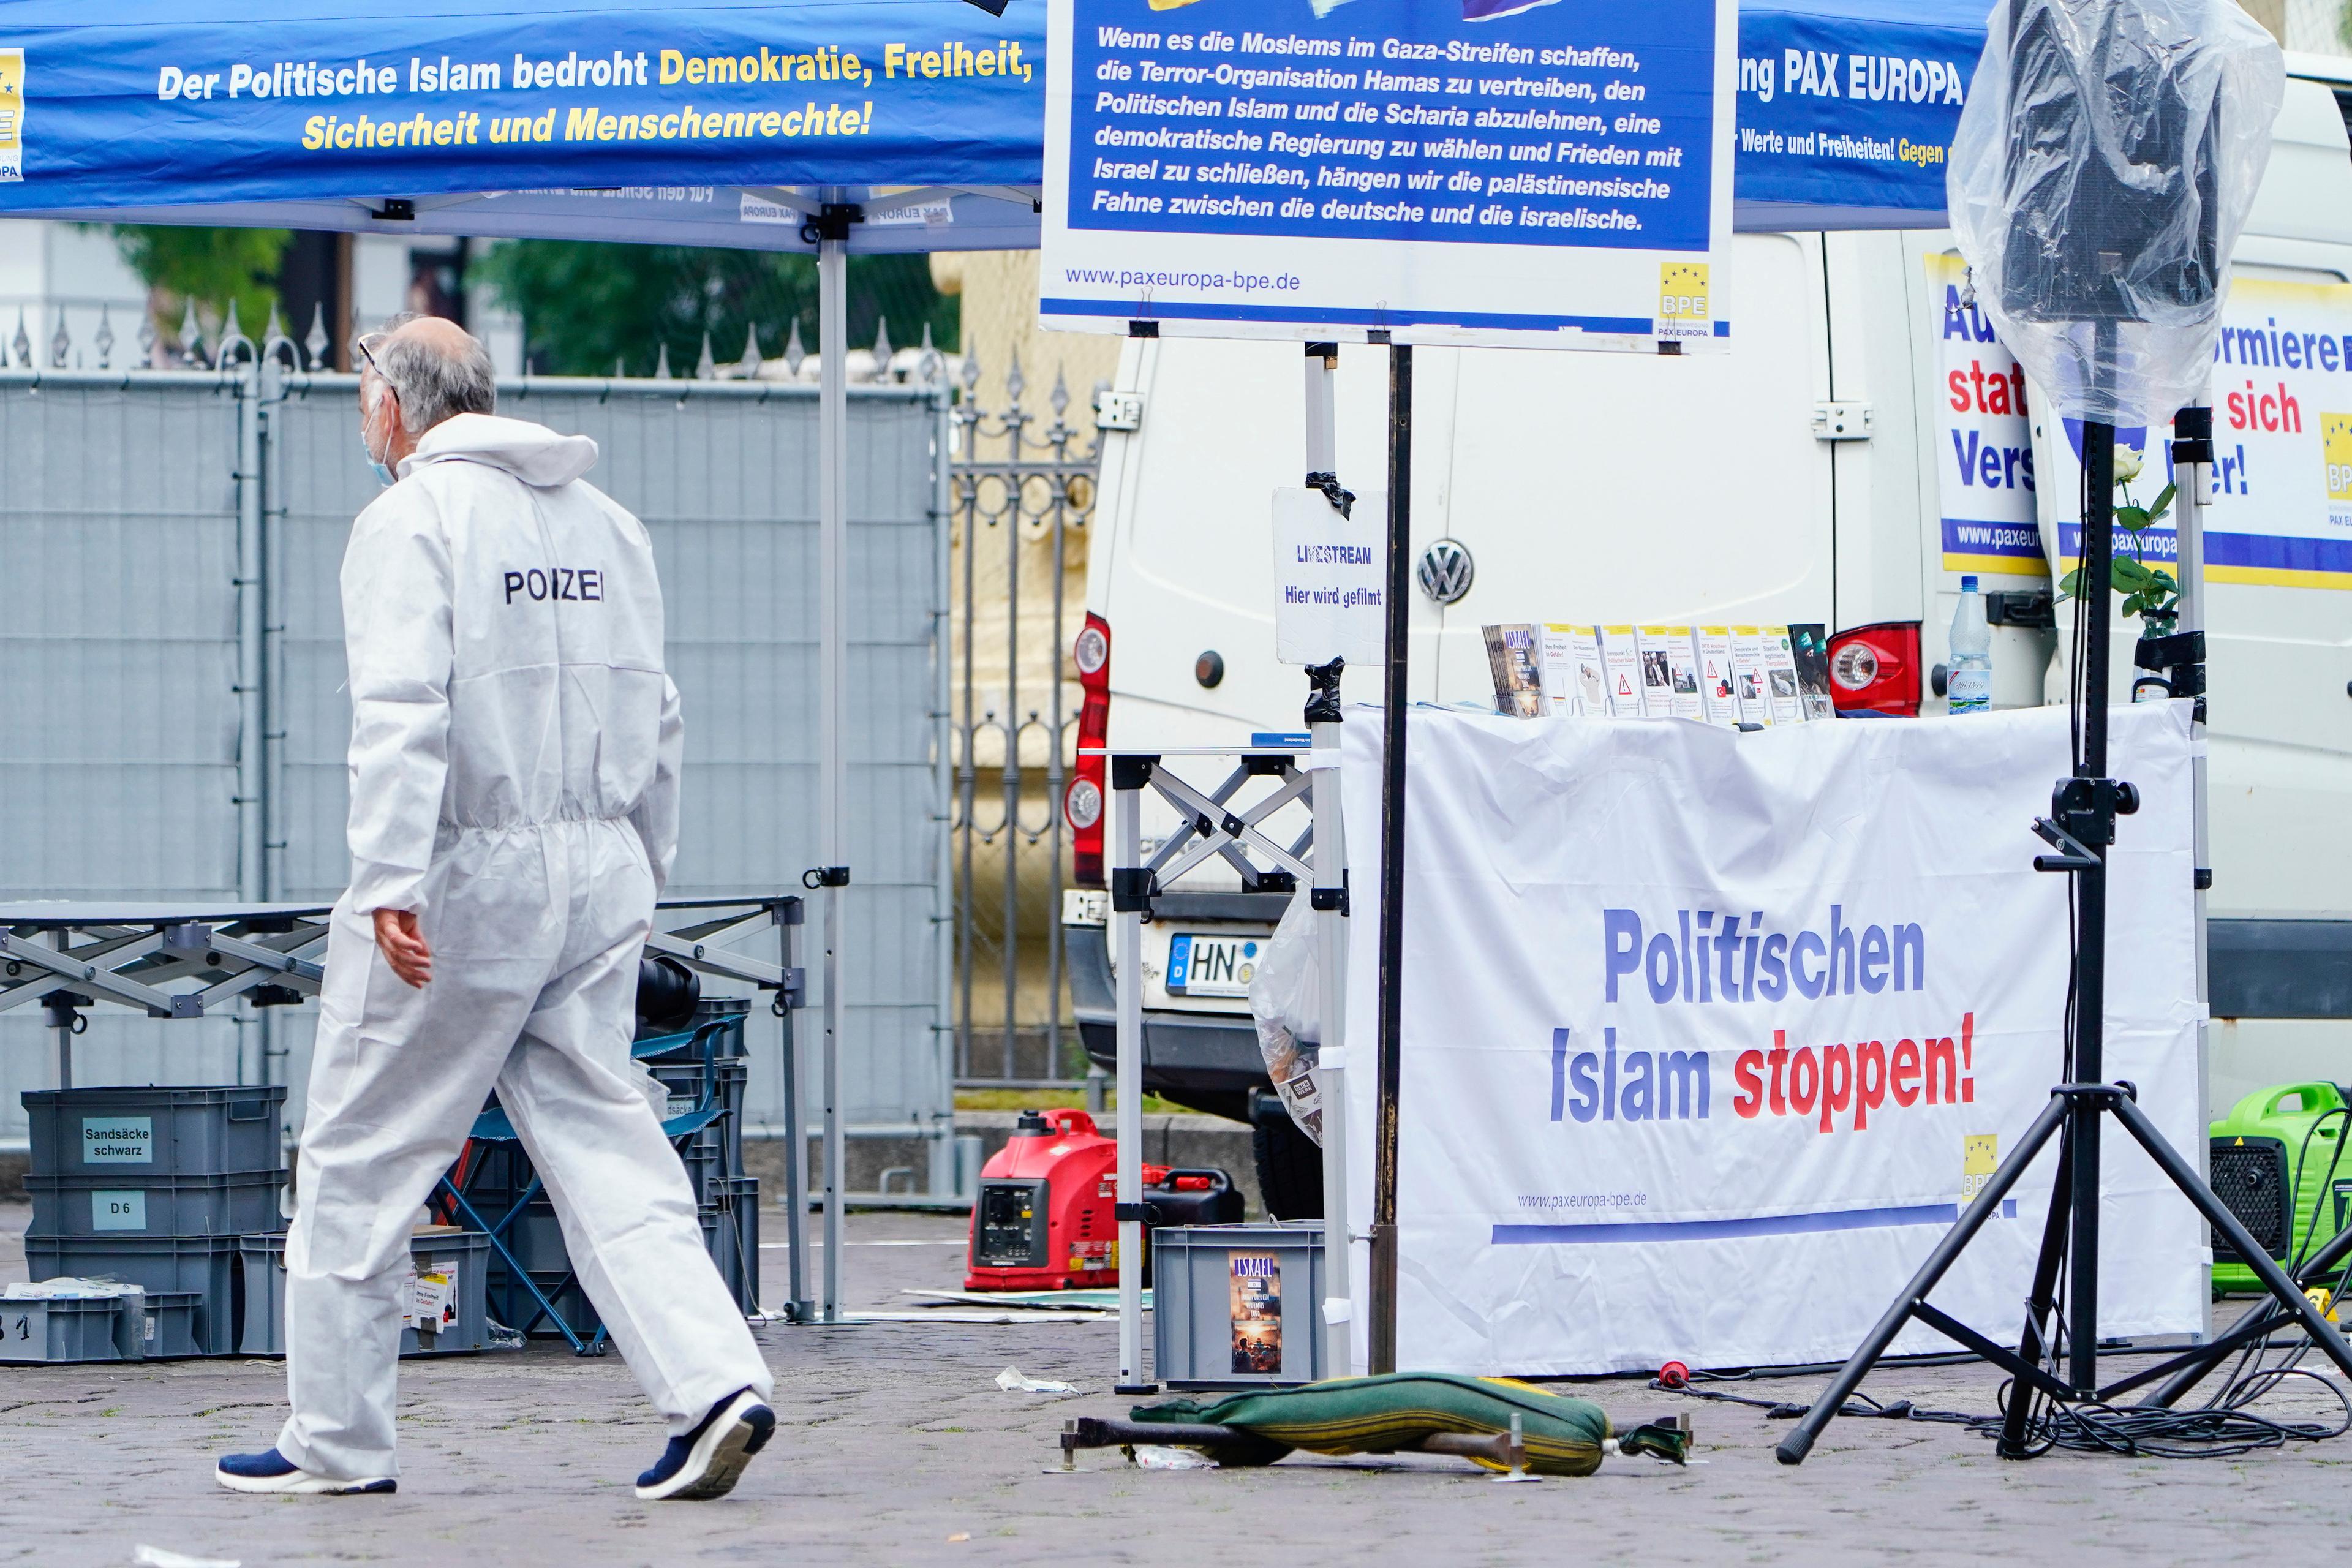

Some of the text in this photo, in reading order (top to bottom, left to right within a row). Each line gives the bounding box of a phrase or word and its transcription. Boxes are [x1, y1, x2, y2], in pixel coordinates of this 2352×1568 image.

[158, 40, 1031, 99] Der Politische Islam bedroht Demokratie, Freiheit,
[1099, 27, 1639, 72] Wenn es die Moslems im Gaza-Streifen schaffen,
[1097, 60, 1645, 103] die Terror-Organisation Hamas zu vertreiben, den
[1785, 49, 1839, 97] PAX
[1850, 55, 1963, 105] EUROPA
[302, 101, 872, 149] Sicherheit und Menschenrechte!
[1096, 92, 1660, 135] Politischen Islam und die Scharia abzulehnen, eine
[1095, 126, 1682, 167] demokratische Regierung zu wählen und Frieden mit
[1741, 129, 1783, 153] Werte
[1789, 132, 1814, 154] und
[1819, 133, 1894, 160] Freiheiten!
[1899, 138, 1943, 167] Gegen
[1094, 158, 1670, 198] Israel zu schließen, hängen wir die palästinensische
[1093, 190, 1642, 230] Fahne zwischen die deutsche und die israelische.
[1066, 270, 1300, 290] www.paxeuropa-bpe.de
[1662, 295, 1706, 315] BPE
[1944, 284, 2003, 342] Au
[2228, 380, 2301, 432] sich
[504, 568, 604, 605] POIZEI
[1419, 540, 1472, 603] VW
[1286, 586, 1381, 608] Hier wird gefilmt
[1174, 966, 1183, 978] D
[1191, 943, 1236, 981] HN
[1603, 904, 1925, 1003] Politischen
[1297, 1086, 1312, 1096] WERK
[1551, 1012, 1975, 1133] Islam stoppen!
[86, 1129, 148, 1139] Sandsäcke
[94, 1145, 141, 1155] schwarz
[111, 1203, 129, 1213] D 6
[1518, 1191, 1647, 1212] www.paxeuropa-bpe.de
[1237, 1257, 1272, 1277] ISRAEL
